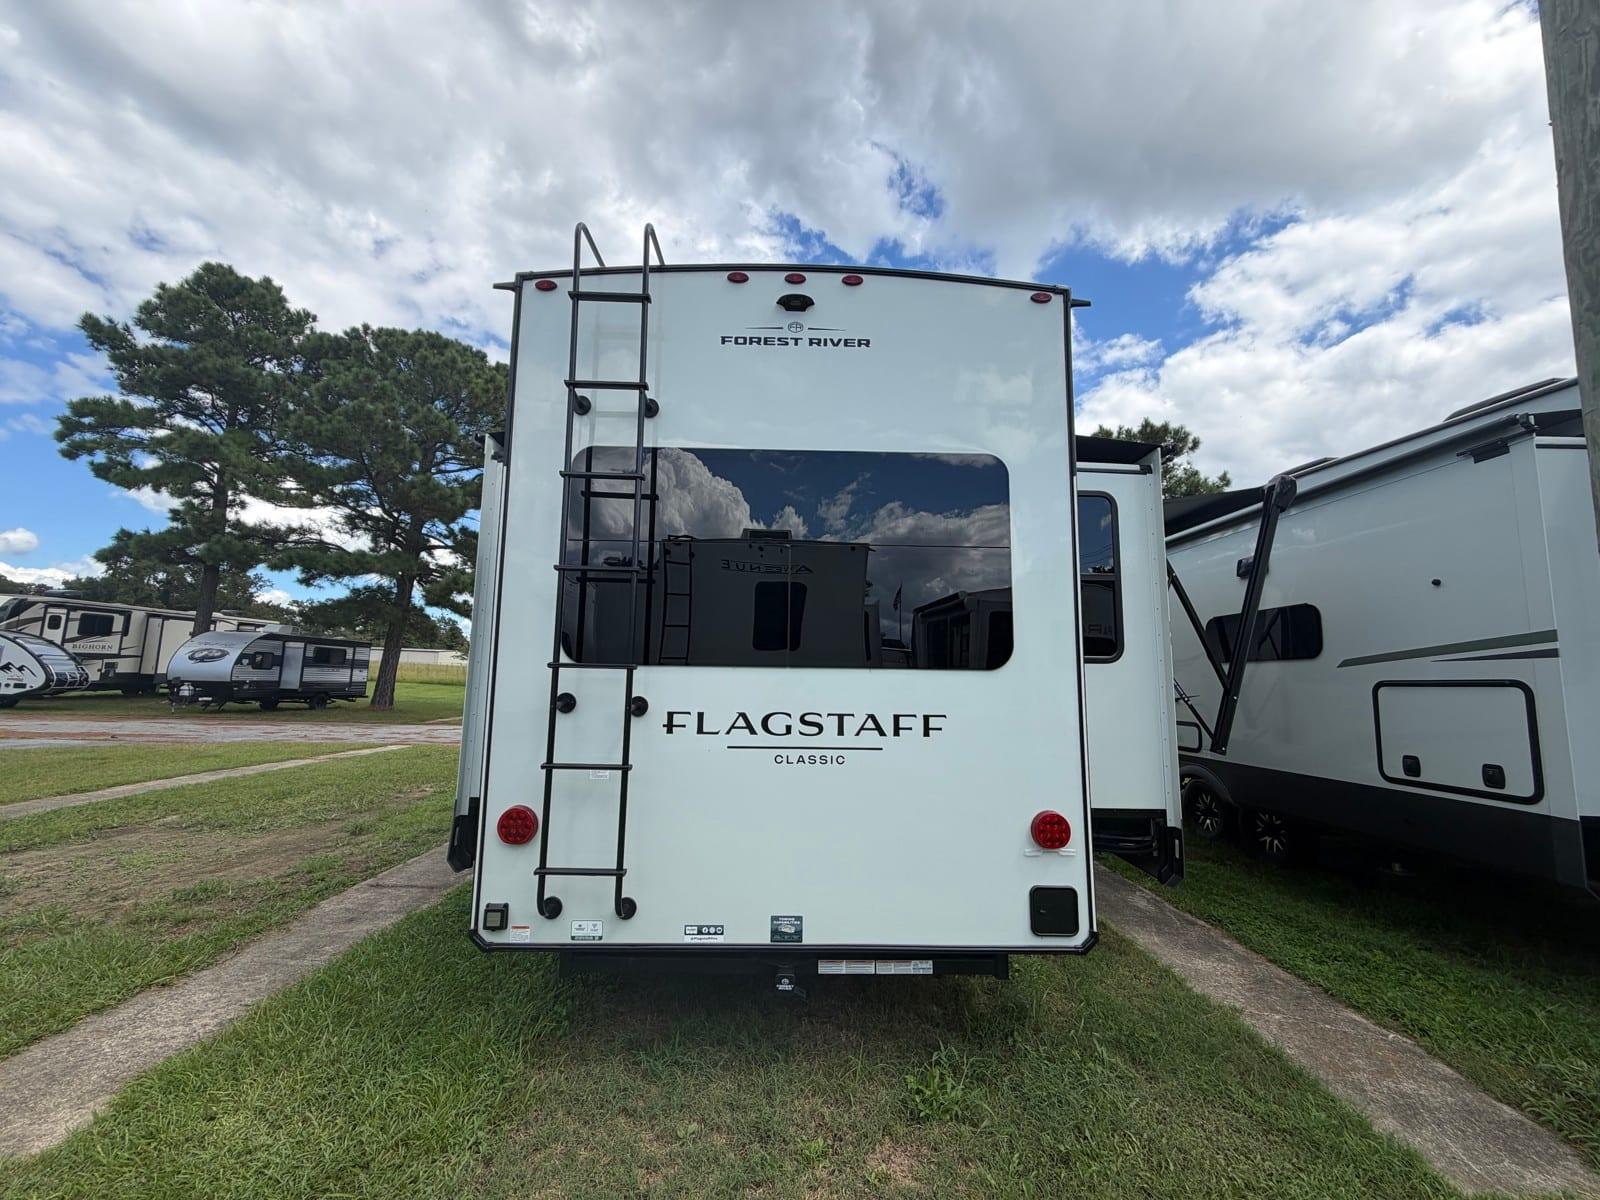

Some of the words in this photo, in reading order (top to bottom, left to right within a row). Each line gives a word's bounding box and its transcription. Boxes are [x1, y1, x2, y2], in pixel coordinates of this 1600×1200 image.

[720, 335, 803, 347] FOREST
[808, 338, 871, 348] RIVER
[72, 643, 113, 651] BIGHORN
[662, 710, 947, 738] FLAGSTAFF
[774, 754, 846, 765] CLASSIC
